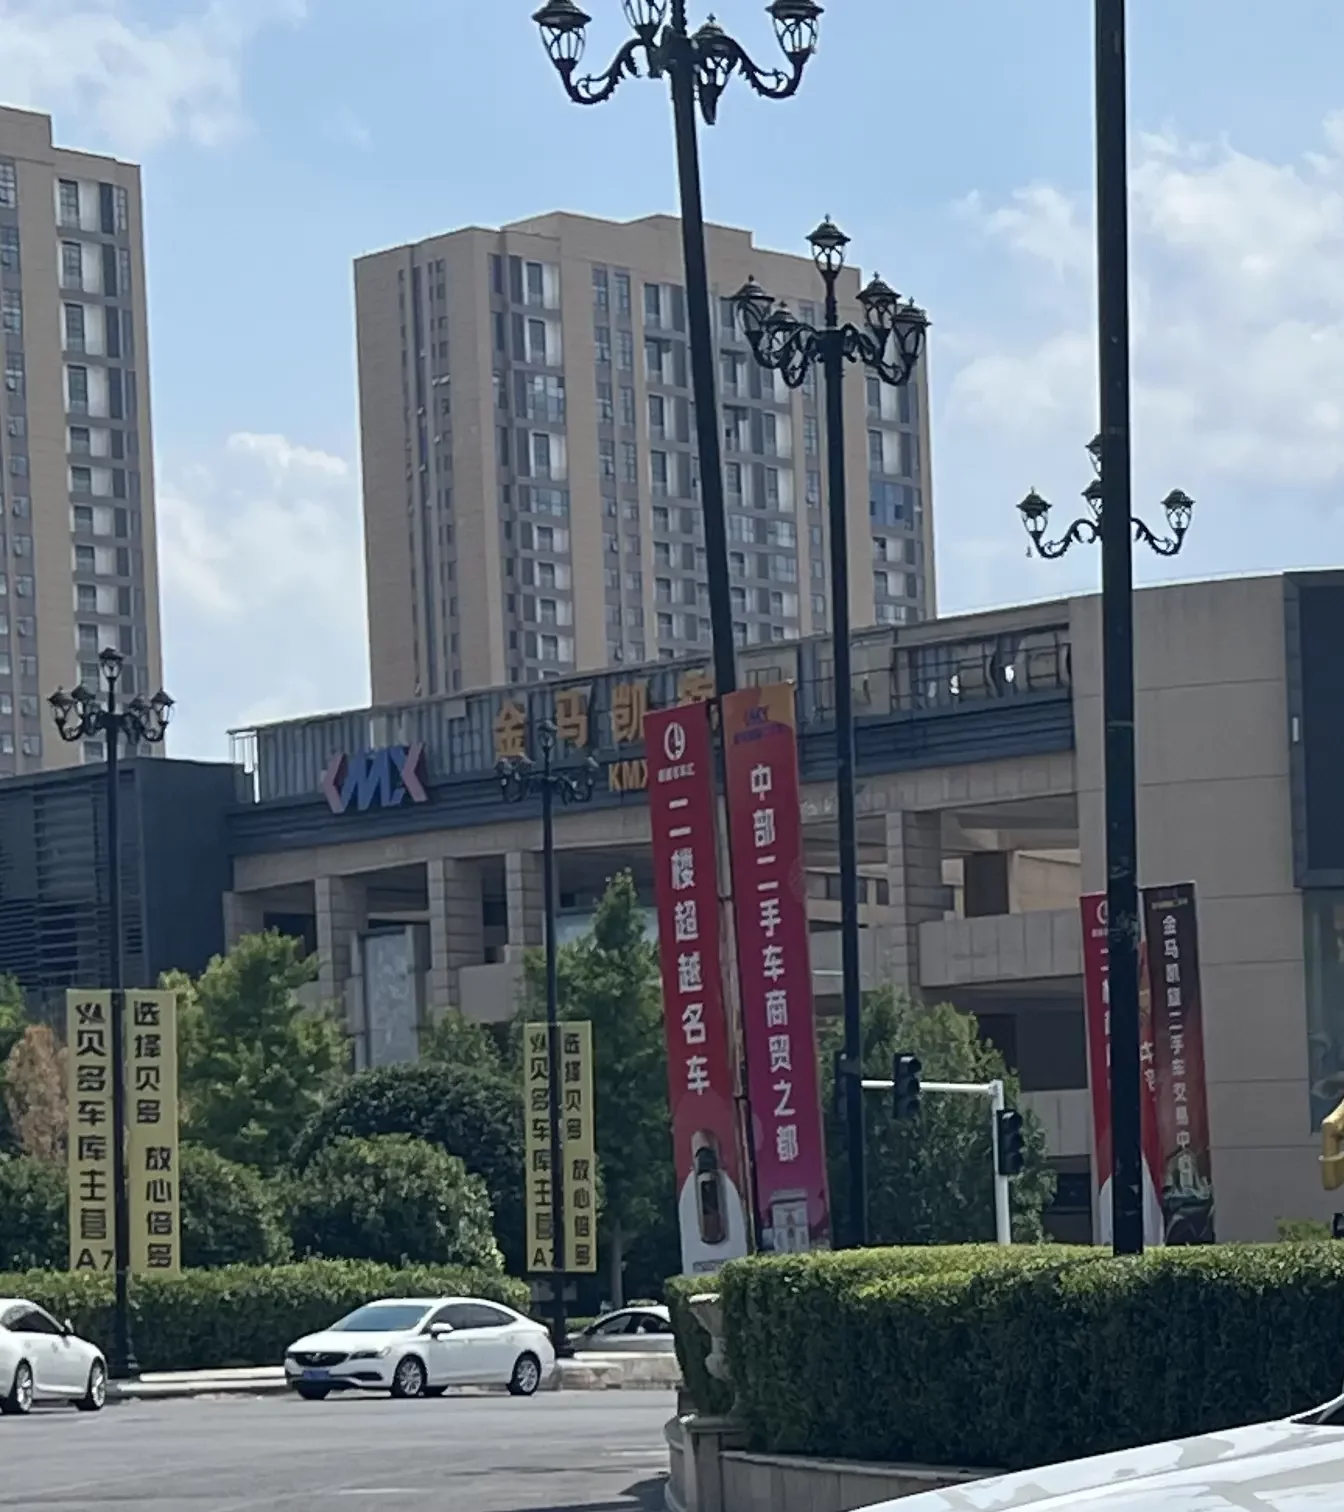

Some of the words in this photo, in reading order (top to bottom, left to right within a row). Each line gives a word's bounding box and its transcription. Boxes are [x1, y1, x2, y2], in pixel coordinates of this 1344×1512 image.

[751, 763, 799, 1162] 中部二手车商贸之都
